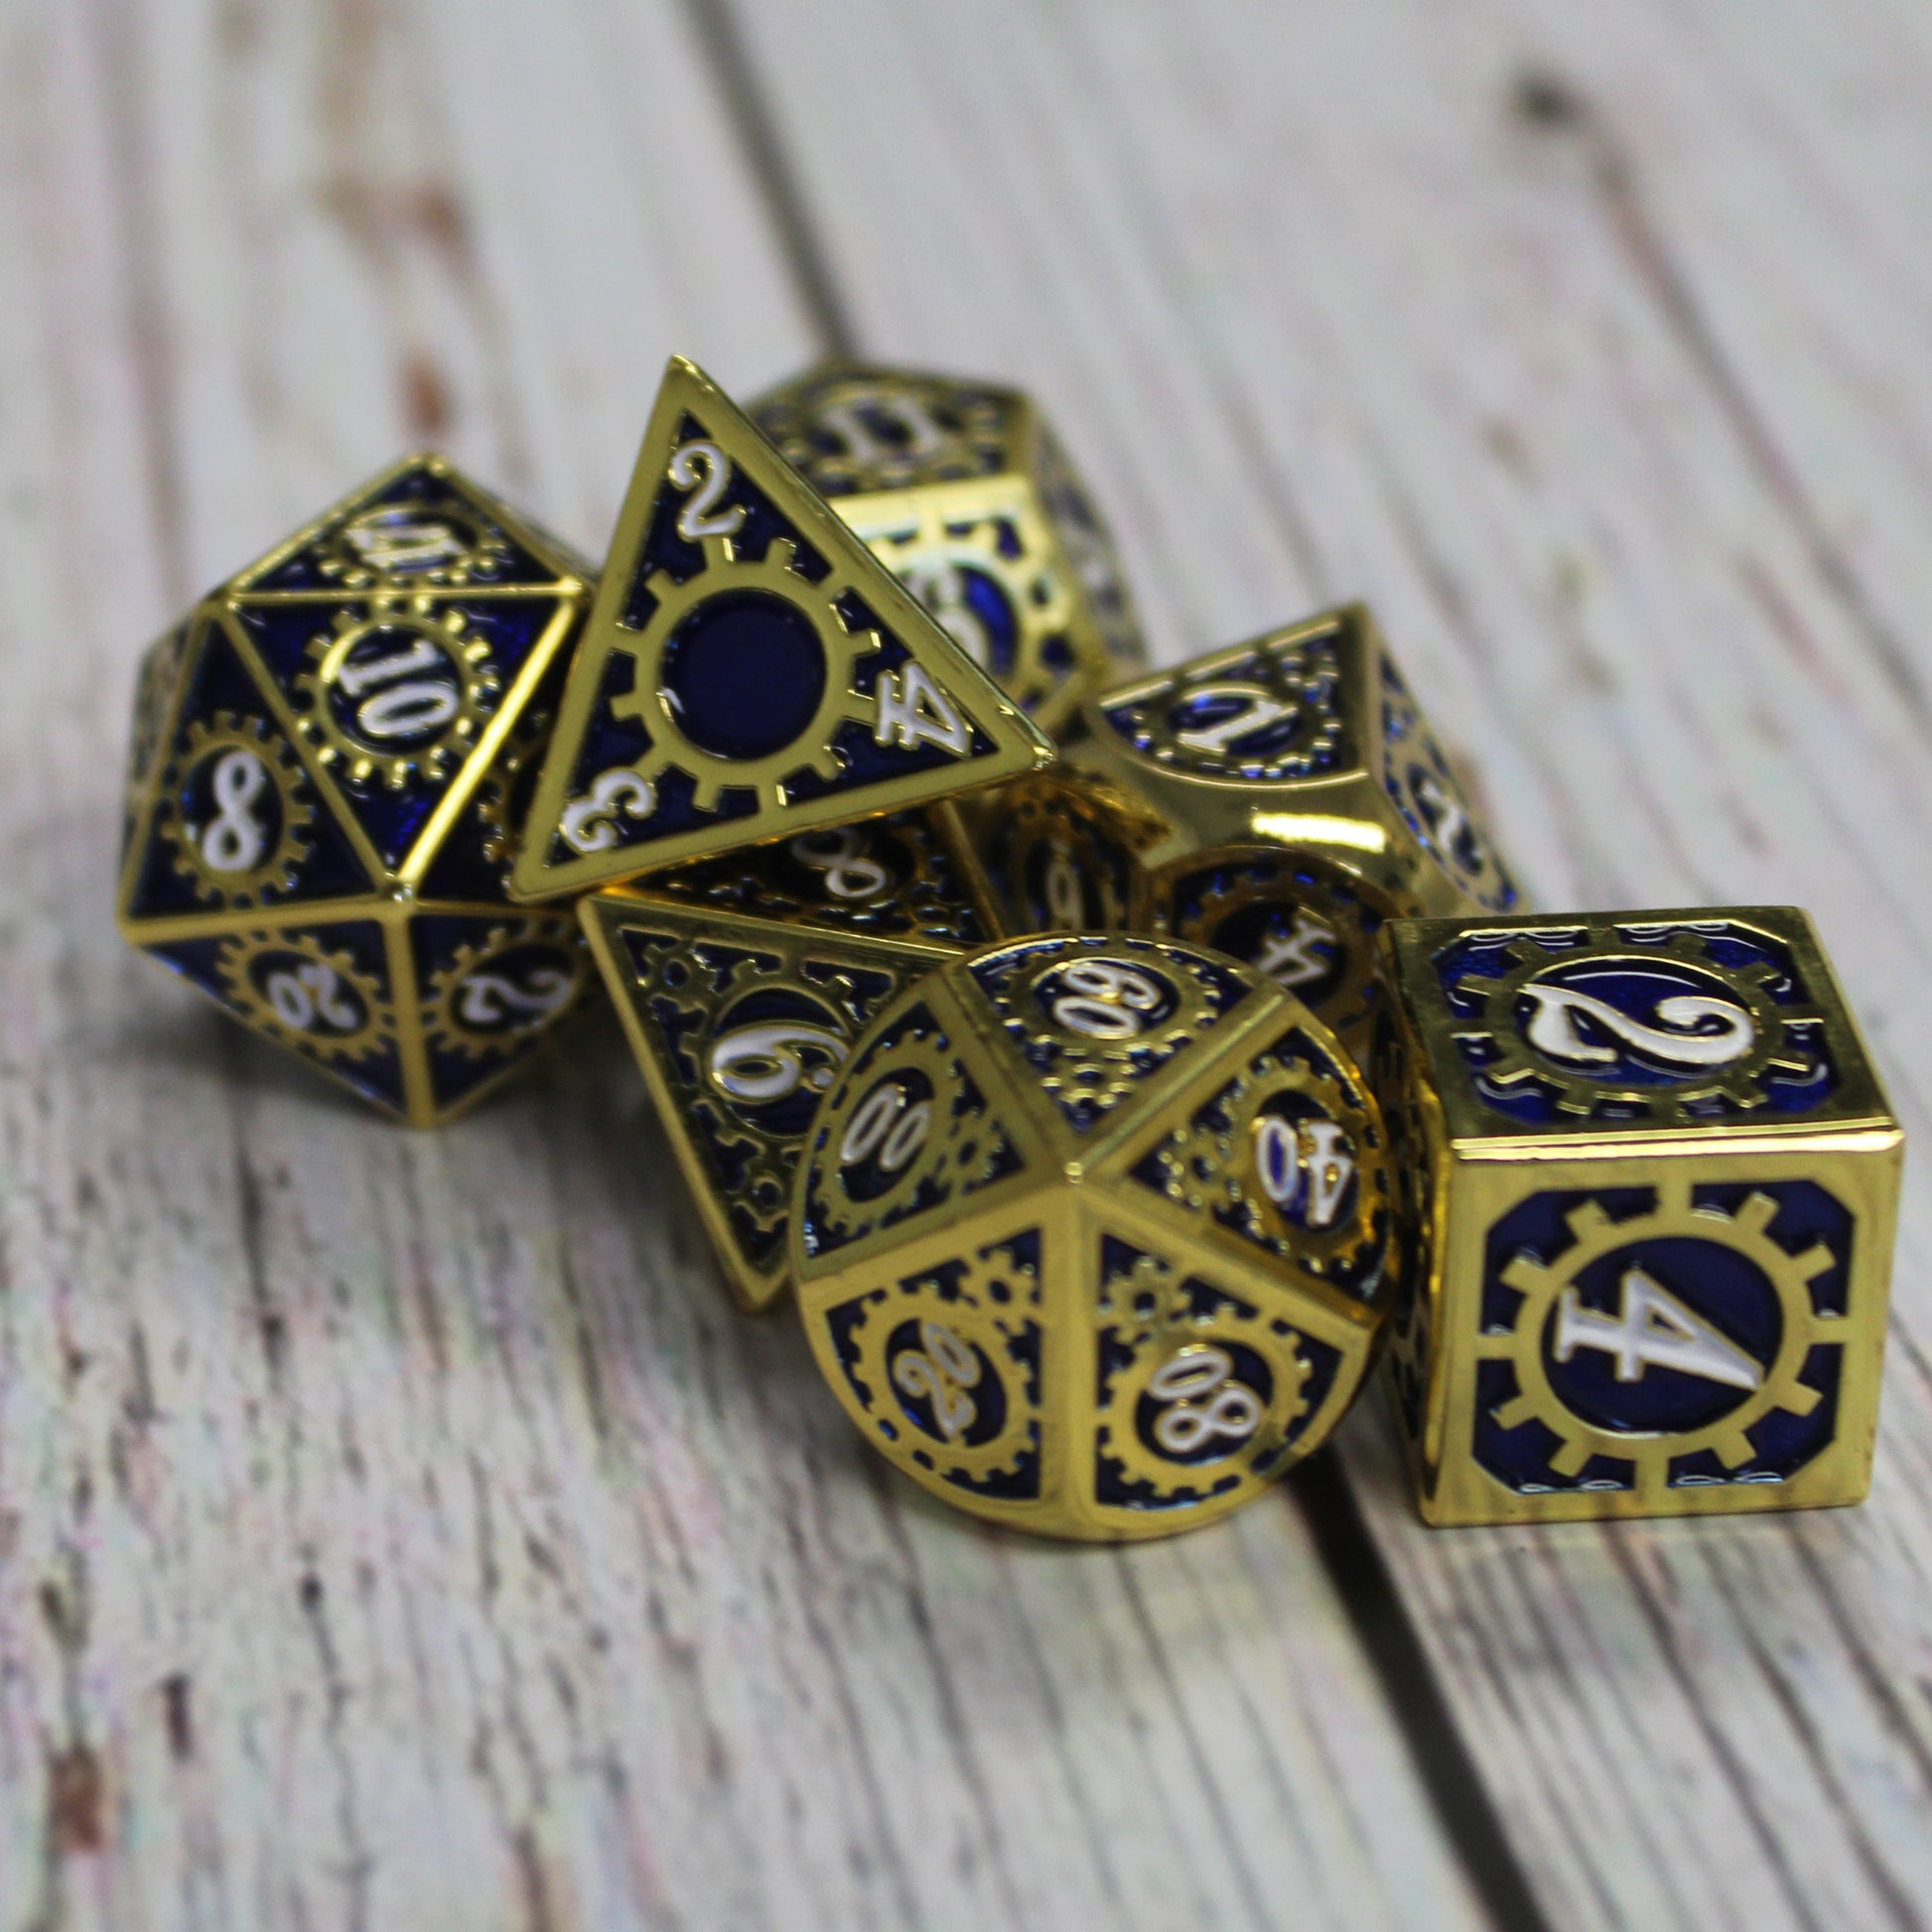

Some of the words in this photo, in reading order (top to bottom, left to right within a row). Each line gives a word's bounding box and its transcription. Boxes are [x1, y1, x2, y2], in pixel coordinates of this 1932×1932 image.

[669, 443, 747, 540] 2
[338, 638, 460, 738] 10
[875, 661, 971, 757] 4
[203, 751, 263, 872] 8
[560, 769, 655, 853] 3
[790, 827, 888, 898] 8
[267, 962, 358, 1030] 20
[462, 971, 572, 1023] 2
[1258, 919, 1336, 984] 4
[1520, 983, 1756, 1064] 2
[840, 1084, 930, 1170] 00
[1256, 1117, 1353, 1225] 40
[1552, 1266, 1765, 1391] 4
[897, 1321, 978, 1437] 20
[1151, 1351, 1260, 1453] 80
